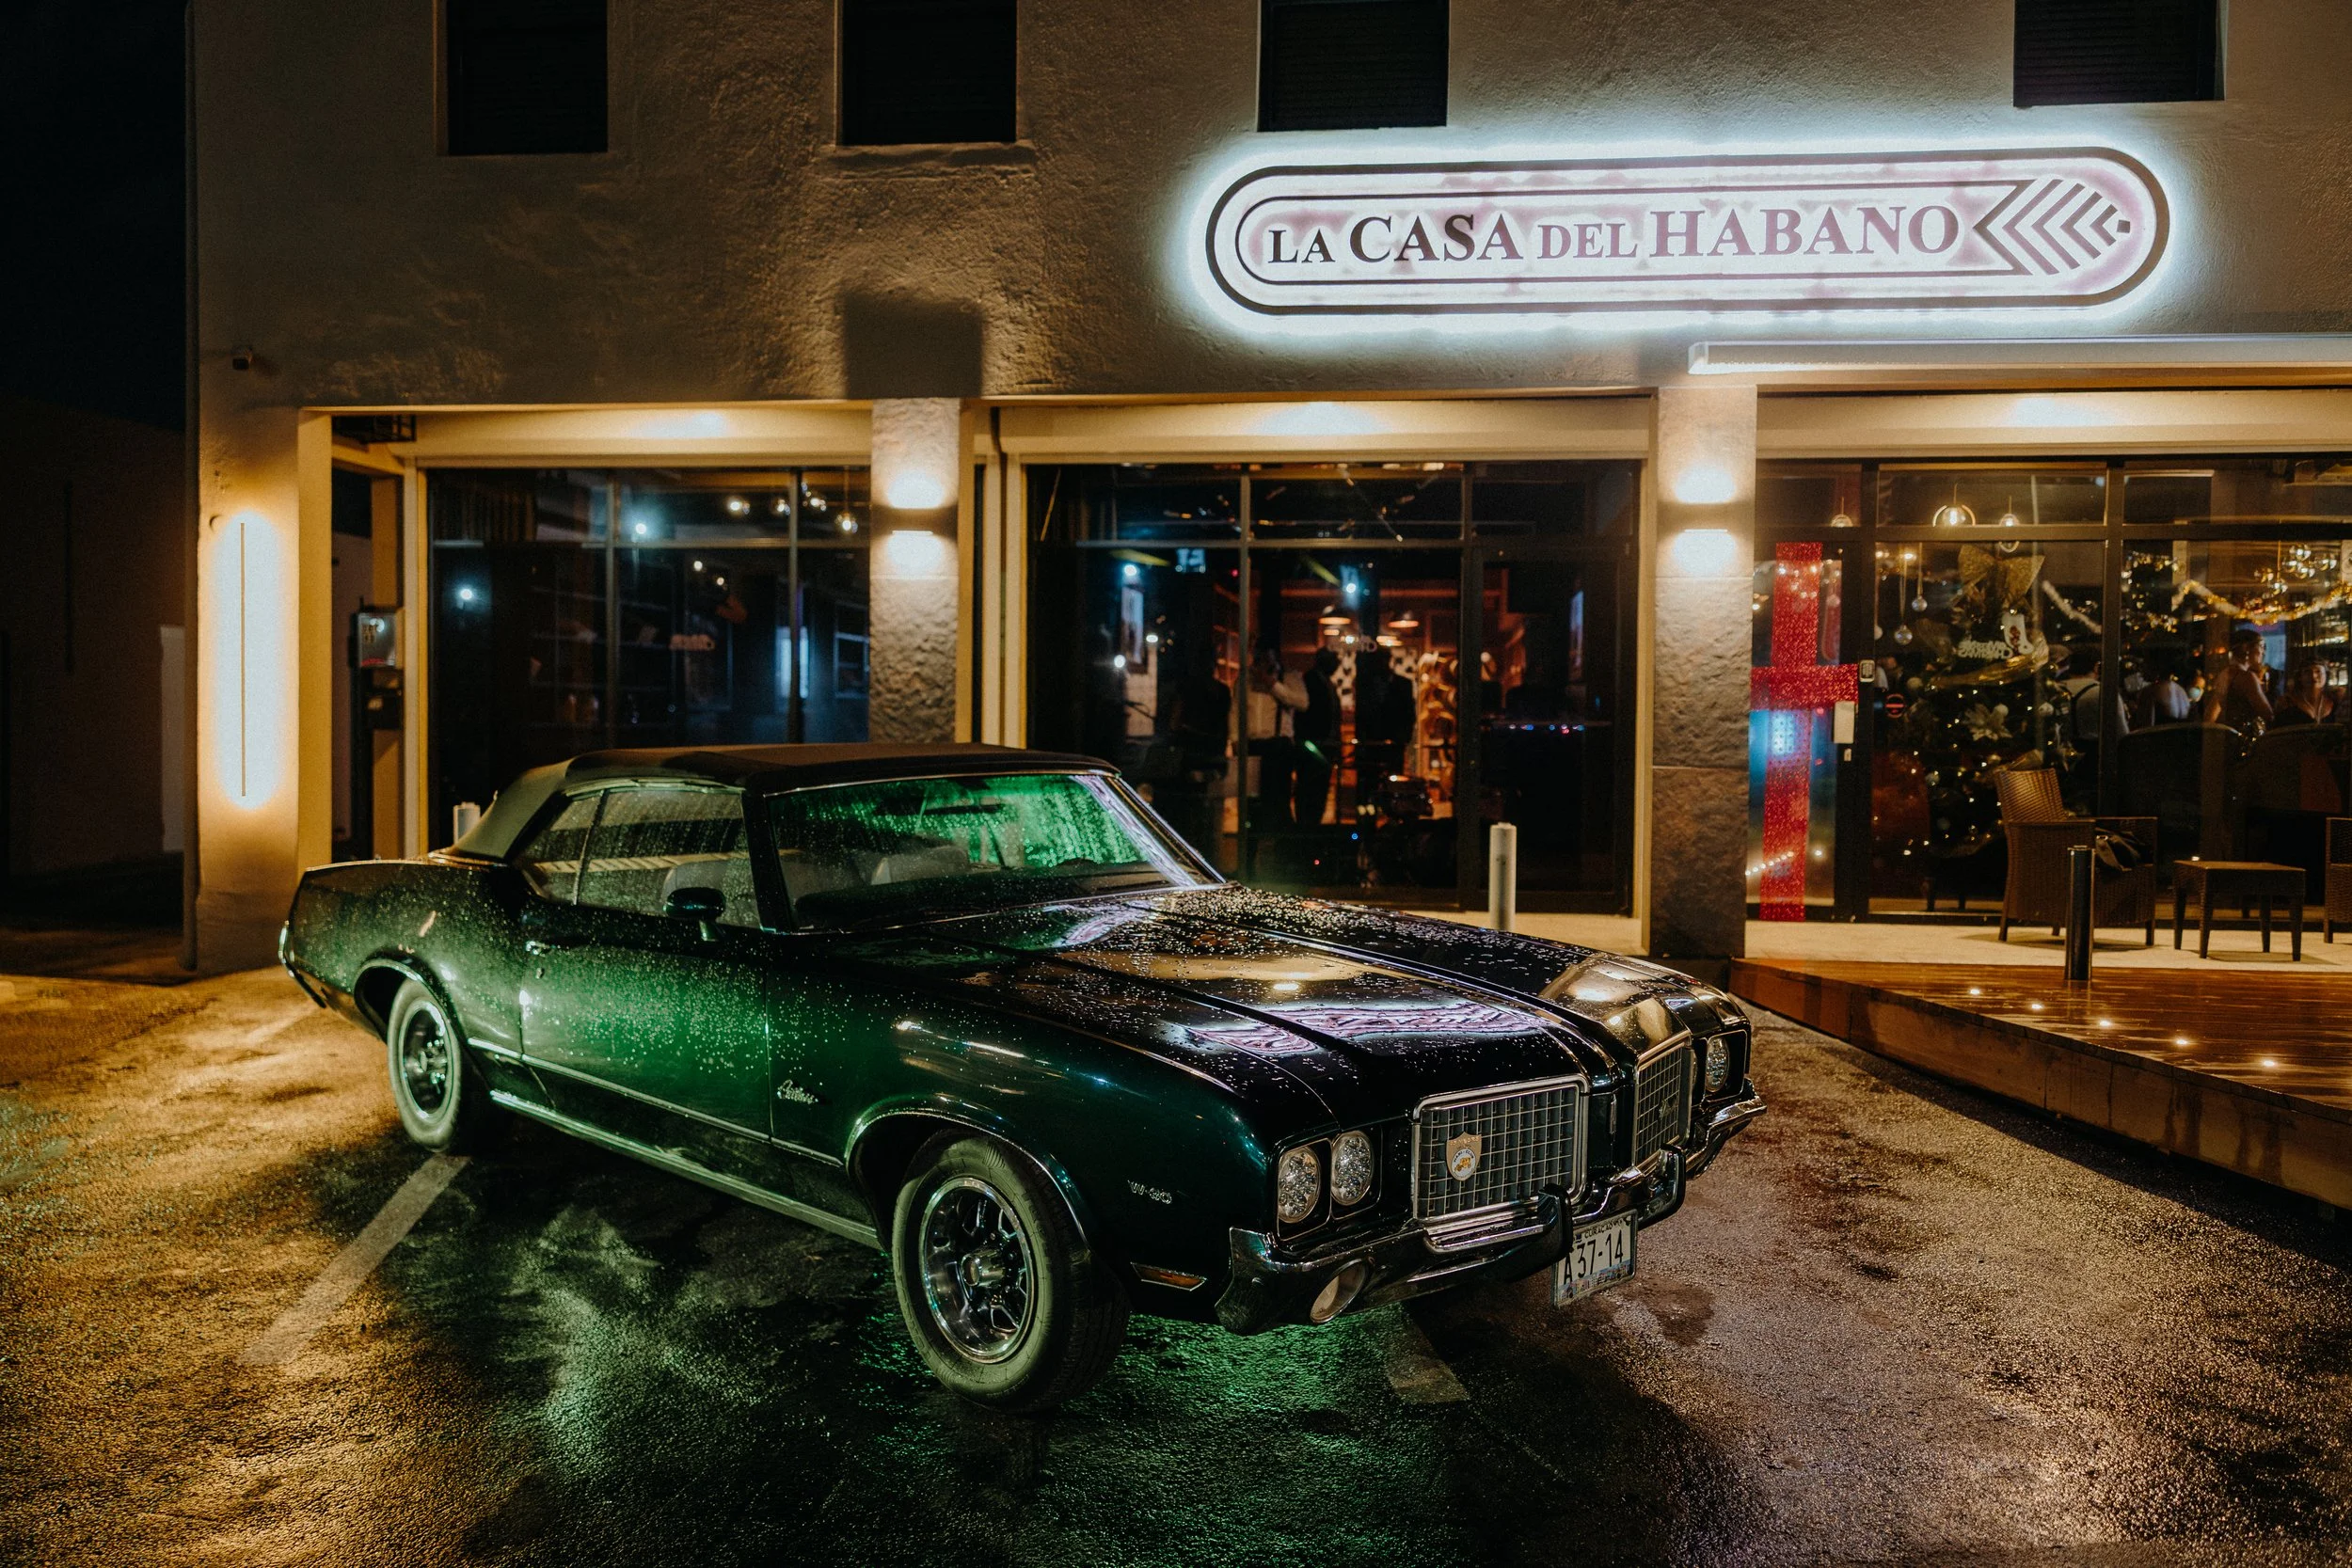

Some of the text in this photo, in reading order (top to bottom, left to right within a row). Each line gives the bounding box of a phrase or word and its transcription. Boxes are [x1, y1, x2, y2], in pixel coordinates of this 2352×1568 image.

[1267, 205, 1960, 263] LA CASA DEL HABANO
